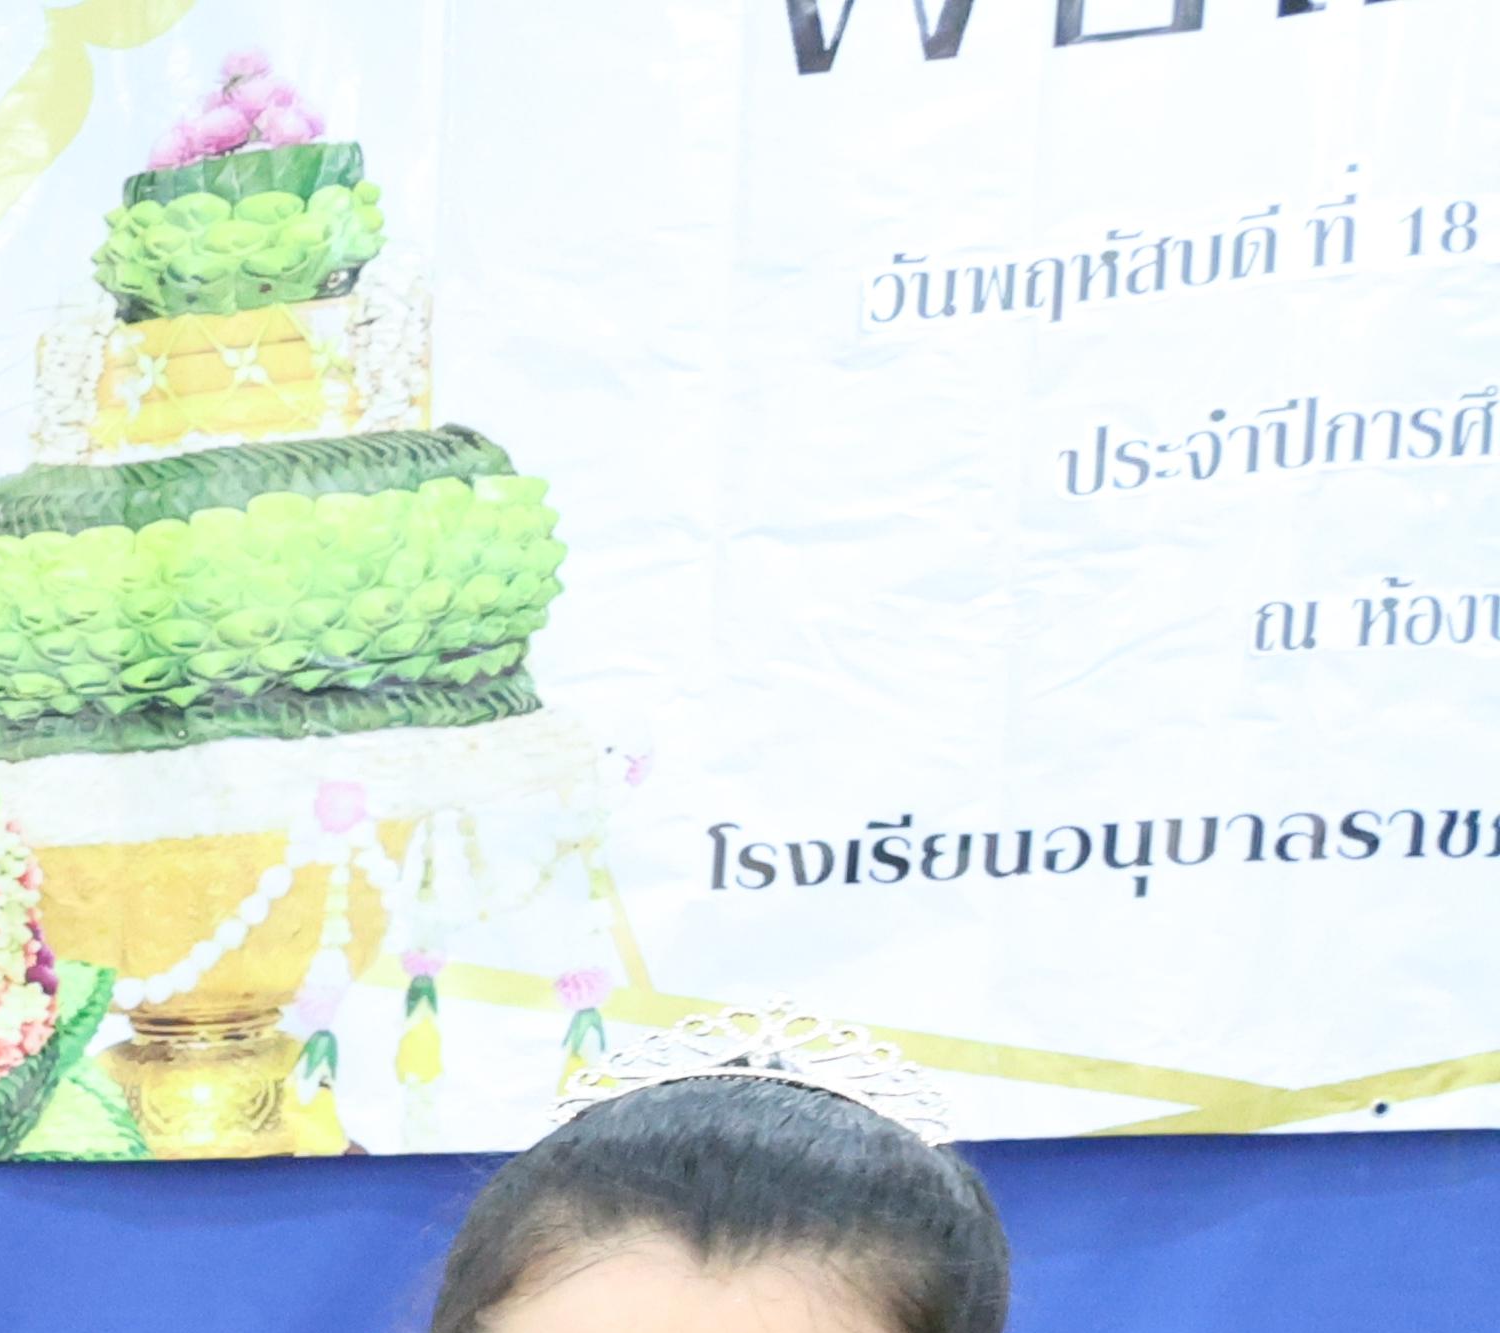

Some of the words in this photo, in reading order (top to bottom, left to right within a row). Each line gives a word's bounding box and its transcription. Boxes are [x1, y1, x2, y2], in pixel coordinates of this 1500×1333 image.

[871, 204, 1280, 322] วันพฤหัสบดี
[1307, 164, 1358, 267] ที่
[1401, 200, 1479, 257] 18
[1255, 601, 1318, 651] ณ
